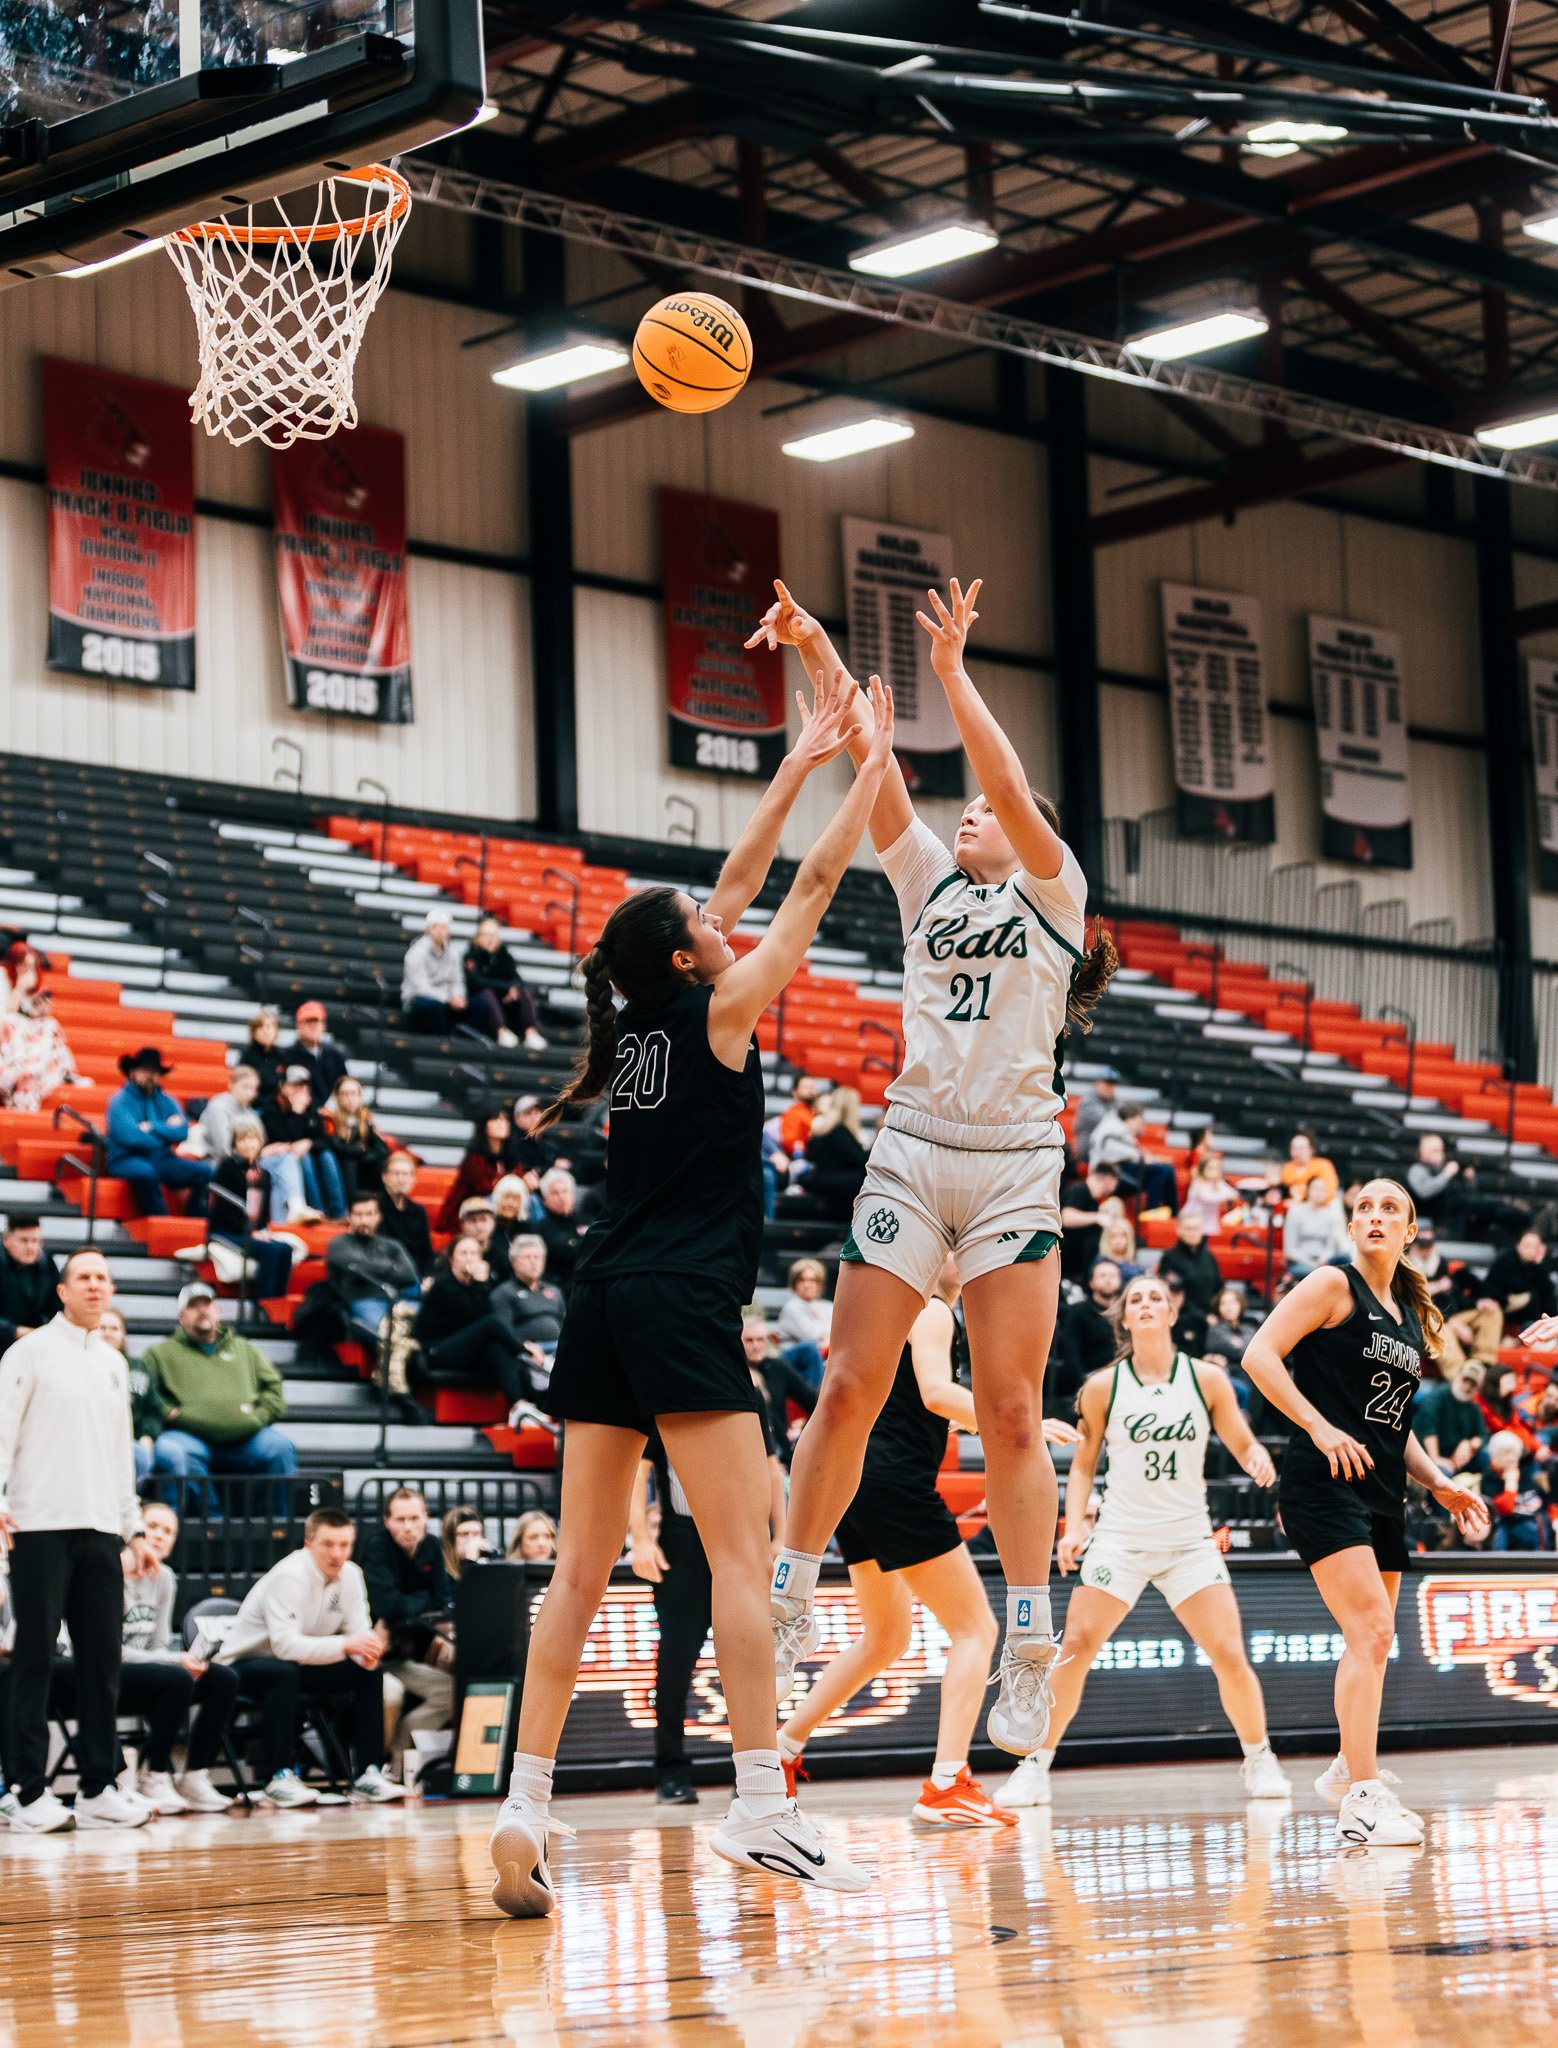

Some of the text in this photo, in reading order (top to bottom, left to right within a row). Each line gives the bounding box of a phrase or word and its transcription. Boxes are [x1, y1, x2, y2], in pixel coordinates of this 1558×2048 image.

[664, 300, 735, 351] Wilson
[81, 632, 161, 682] 2015
[925, 914, 1028, 961] Cats
[944, 971, 992, 1022] 21
[610, 1030, 671, 1111] 20
[1364, 1370, 1412, 1431] 24
[1124, 1411, 1196, 1443] Cats
[1144, 1450, 1178, 1481] 34
